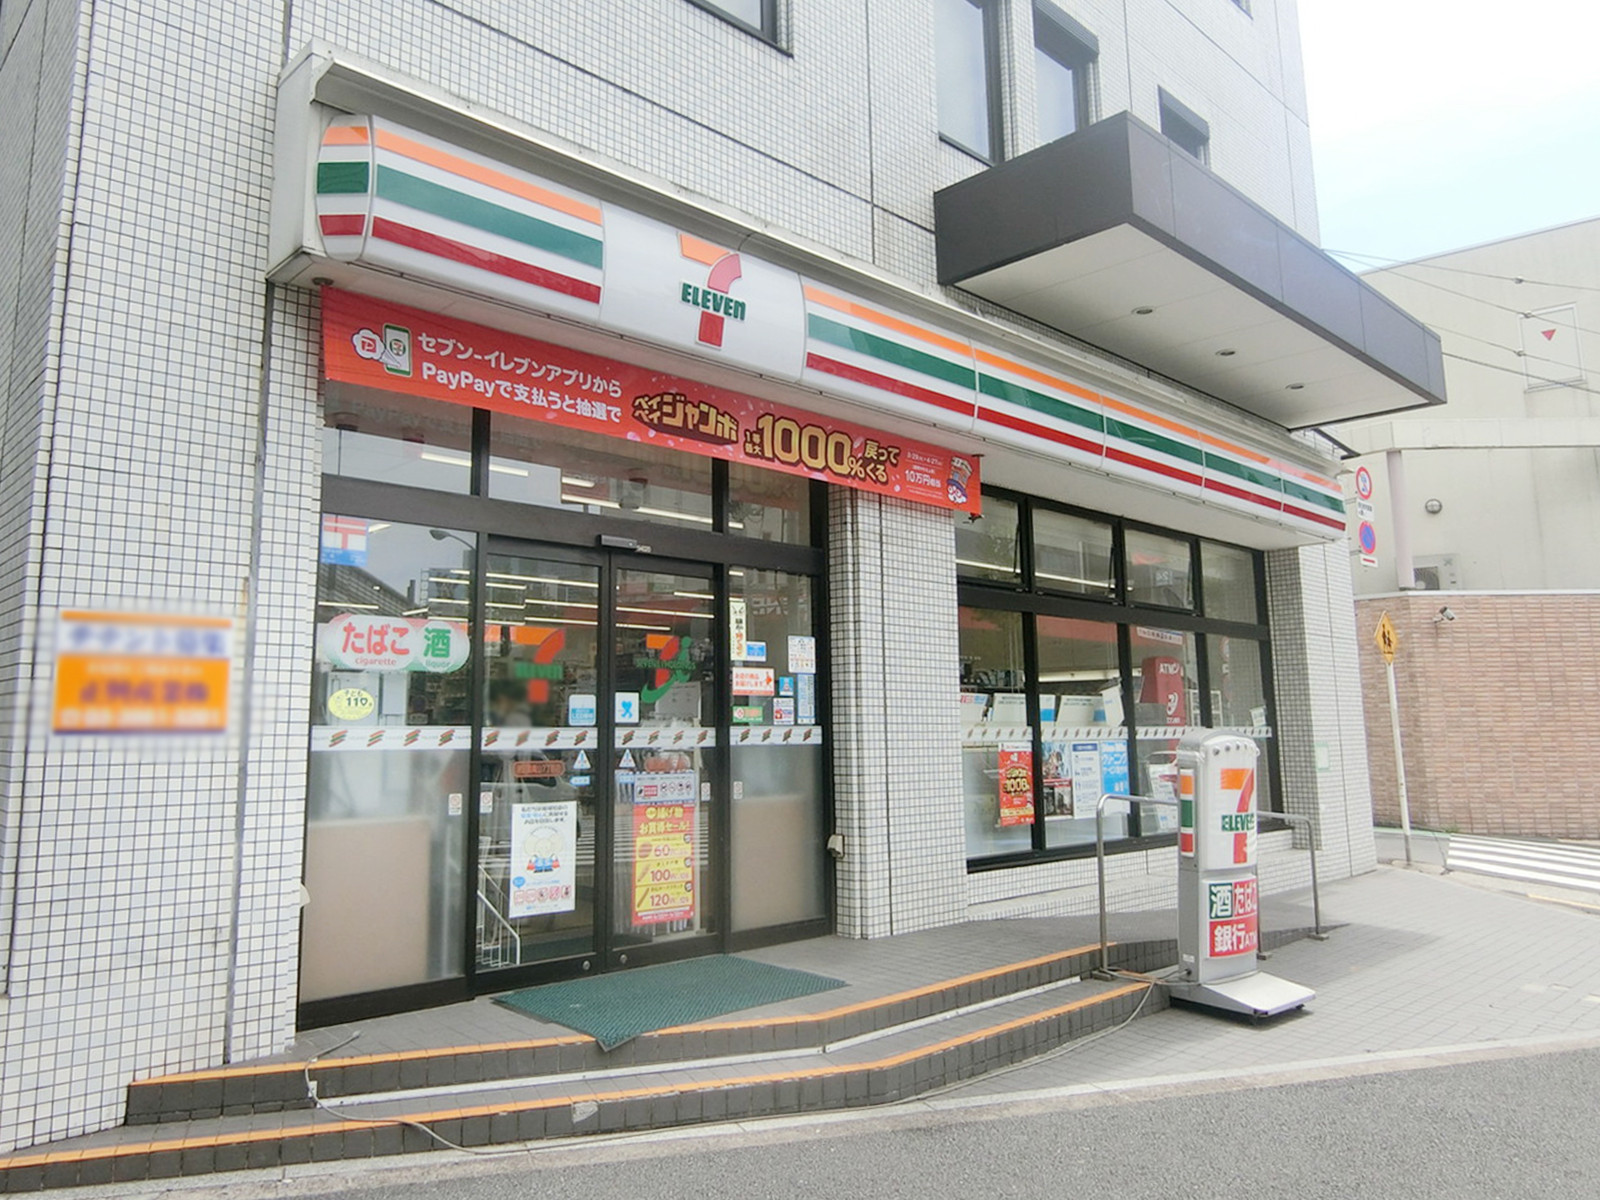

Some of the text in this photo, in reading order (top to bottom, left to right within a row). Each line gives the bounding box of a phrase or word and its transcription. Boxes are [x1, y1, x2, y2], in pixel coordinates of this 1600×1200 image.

[422, 363, 622, 424] PayPayで支払うと抽選で
[342, 621, 410, 656] たばこ
[423, 627, 452, 658] 酒
[355, 657, 397, 667] cigarette
[1211, 885, 1232, 918] 酒
